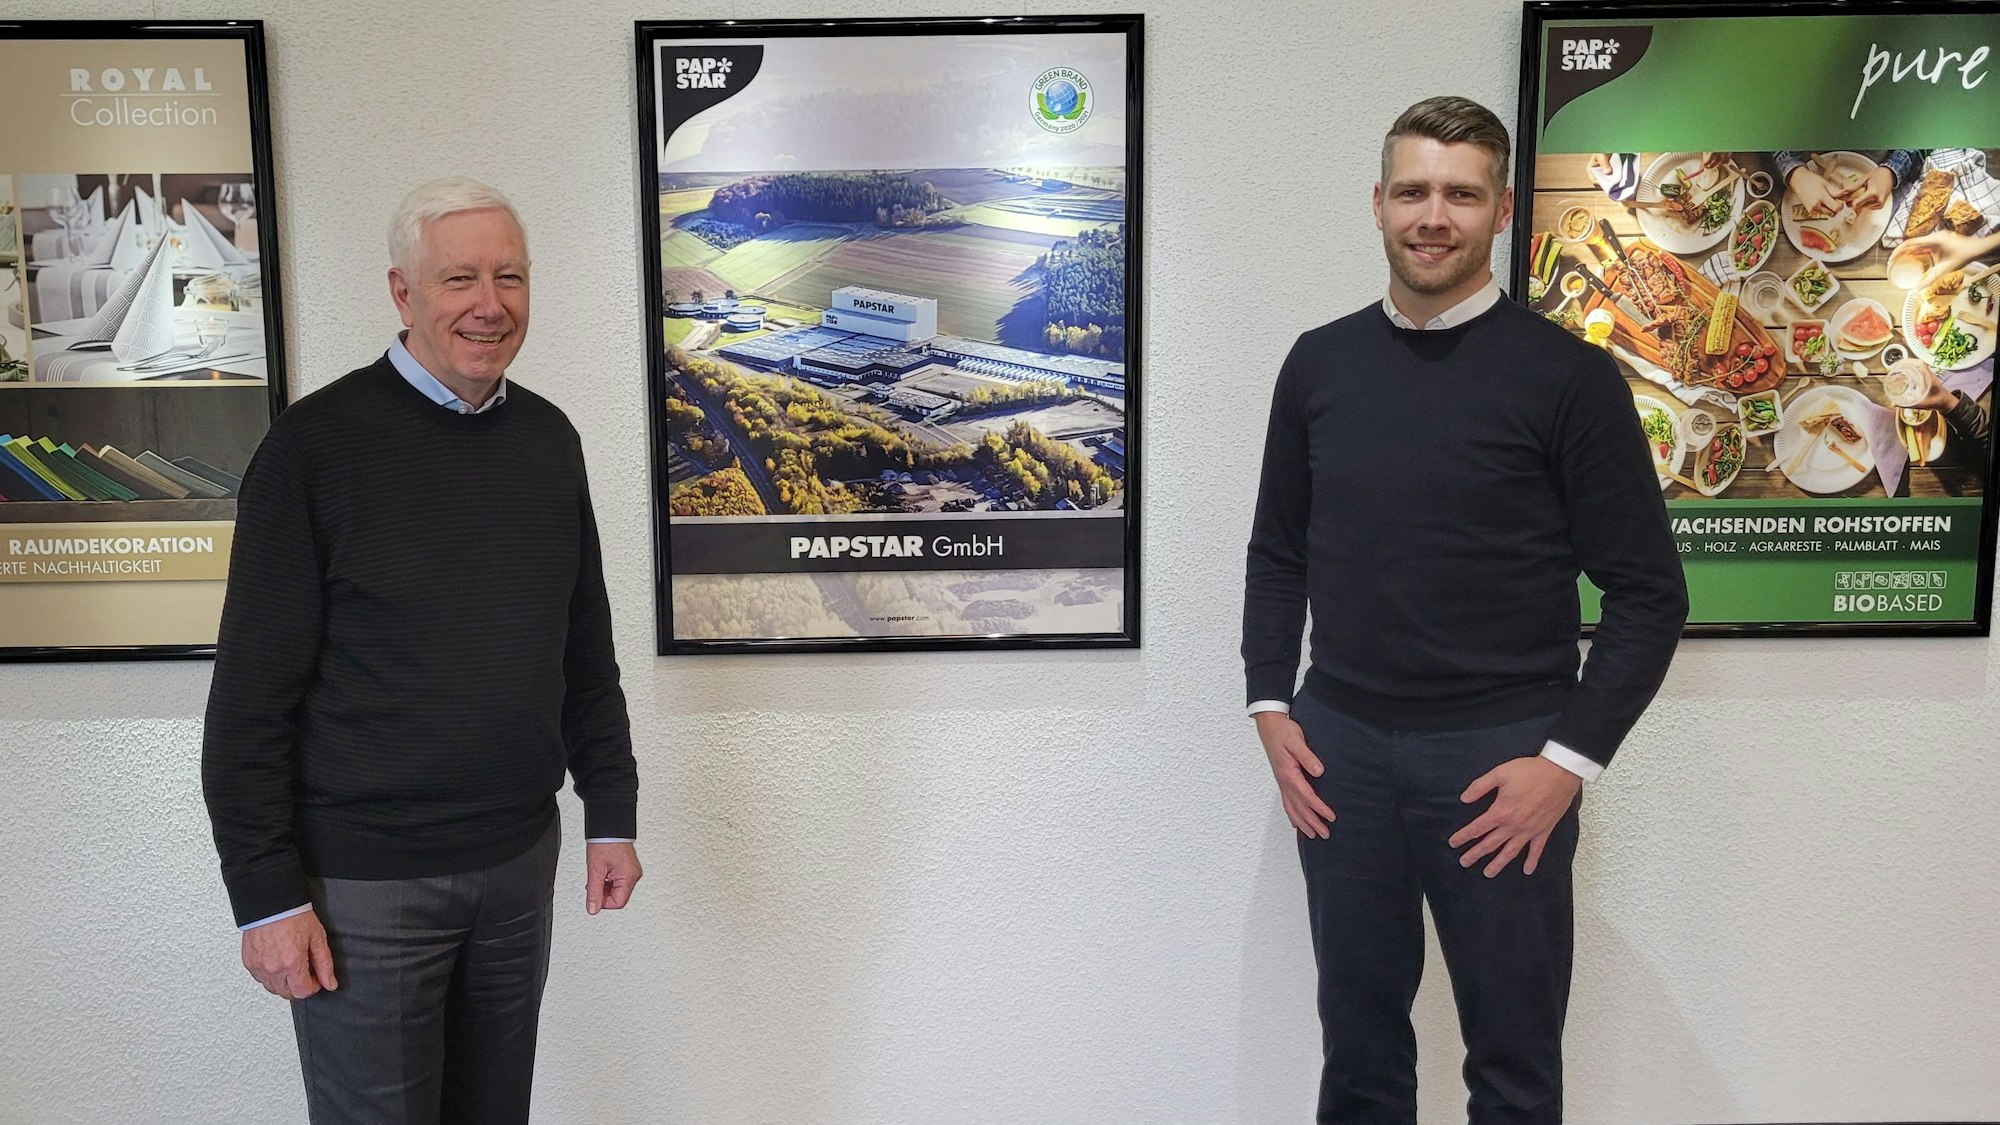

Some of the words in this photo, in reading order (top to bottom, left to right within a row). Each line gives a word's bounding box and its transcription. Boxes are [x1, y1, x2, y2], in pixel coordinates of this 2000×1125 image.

[1562, 39, 1604, 55] PAP
[675, 57, 717, 74] PAP
[1561, 54, 1612, 71] STAR
[69, 67, 213, 92] ROYAL
[676, 73, 727, 89] STAR
[1034, 69, 1060, 91] GREEN
[1061, 69, 1088, 91] BRAND
[1850, 43, 1990, 120] pure
[70, 97, 217, 126] Collection
[1034, 111, 1060, 133] Germany
[853, 298, 895, 314] PAPSTAR
[1813, 515, 1952, 534] ROHSTOFFEN
[9, 536, 214, 556] RAUMDEKORATION
[790, 535, 924, 559] PAPSTAR
[932, 533, 1004, 557] GmbH
[1704, 541, 1737, 553] HOLZ
[1748, 540, 1823, 552] AGRARRESTE
[1834, 540, 1899, 552] PALMBLATT
[1909, 539, 1942, 551] MAIS
[33, 559, 163, 575] NACHHALTIGKEIT
[1833, 594, 1944, 613] BIOBASED
